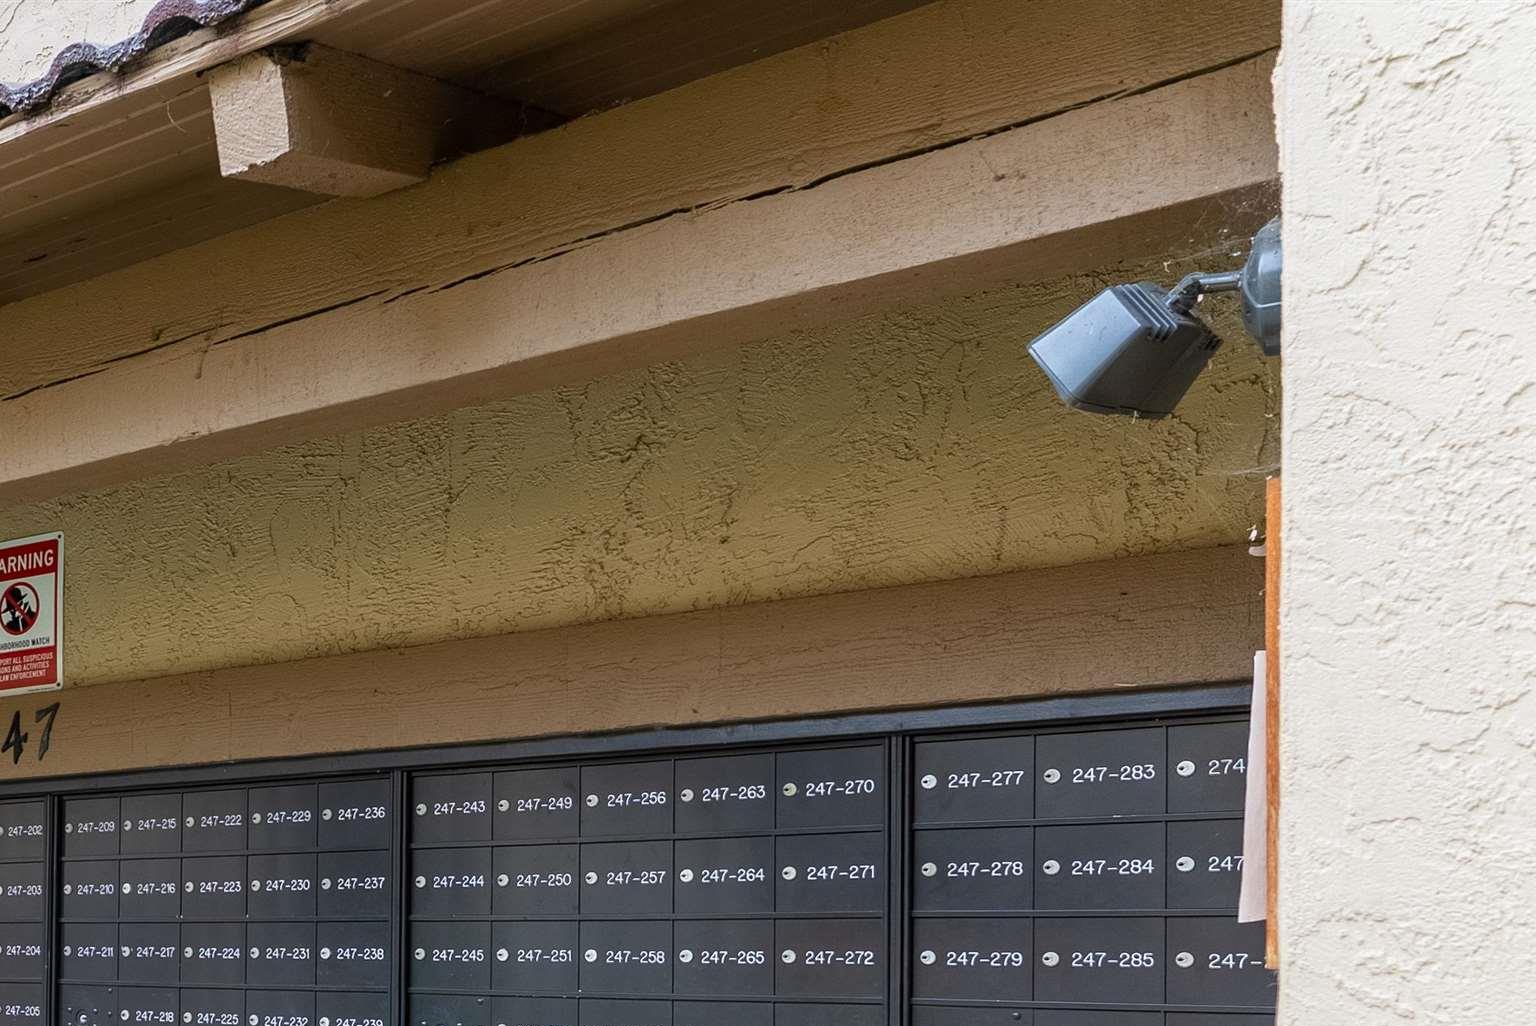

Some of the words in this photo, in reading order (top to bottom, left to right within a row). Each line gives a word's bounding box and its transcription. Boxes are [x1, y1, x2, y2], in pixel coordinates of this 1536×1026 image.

[31, 636, 50, 648] WATCH
[13, 656, 21, 664] ALL
[23, 652, 54, 663] SUSPICIOUS
[12, 664, 22, 672] AND
[23, 661, 49, 670] ACTIVITIES
[0, 674, 9, 682] LAW
[10, 669, 46, 681] ENFORCEMENT
[949, 771, 1024, 788] 247-277
[1073, 765, 1155, 783] 247-283
[703, 786, 765, 801] 247-263
[806, 780, 874, 796] 247-270
[518, 797, 572, 811] 247-249
[608, 792, 666, 806] 247-256
[339, 807, 385, 820] 247-236
[434, 801, 485, 815] 247-243
[201, 815, 241, 827] 247-222
[267, 810, 311, 823] 247-229
[78, 821, 114, 833] 247-209
[138, 818, 176, 830] 247-215
[8, 825, 43, 836] 247-202
[807, 865, 874, 880] 247-271
[948, 862, 1023, 876] 247-278
[1072, 860, 1154, 874] 247-284
[517, 874, 571, 886] 247-250
[607, 871, 665, 884] 247-257
[702, 869, 765, 882] 247-264
[200, 881, 241, 892] 247-223
[266, 880, 310, 891] 247-230
[338, 877, 385, 889] 247-237
[434, 876, 484, 888] 247-244
[8, 885, 42, 895] 247-203
[78, 884, 113, 894] 247-210
[138, 883, 175, 894] 247-216
[7, 946, 40, 955] 247-204
[78, 947, 113, 957] 247-211
[137, 947, 175, 957] 247-217
[199, 948, 240, 959] 247-224
[266, 948, 309, 959] 247-231
[337, 948, 384, 960] 247-238
[433, 950, 484, 961] 247-245
[518, 950, 571, 961] 247-251
[607, 951, 665, 963] 247-258
[702, 951, 764, 964] 247-265
[806, 951, 874, 964] 247-272
[947, 952, 1022, 966] 247-279
[1072, 953, 1153, 967] 247-285
[6, 1005, 40, 1016] 247-205
[136, 1011, 174, 1022] 247-218
[198, 1013, 238, 1024] 247-225
